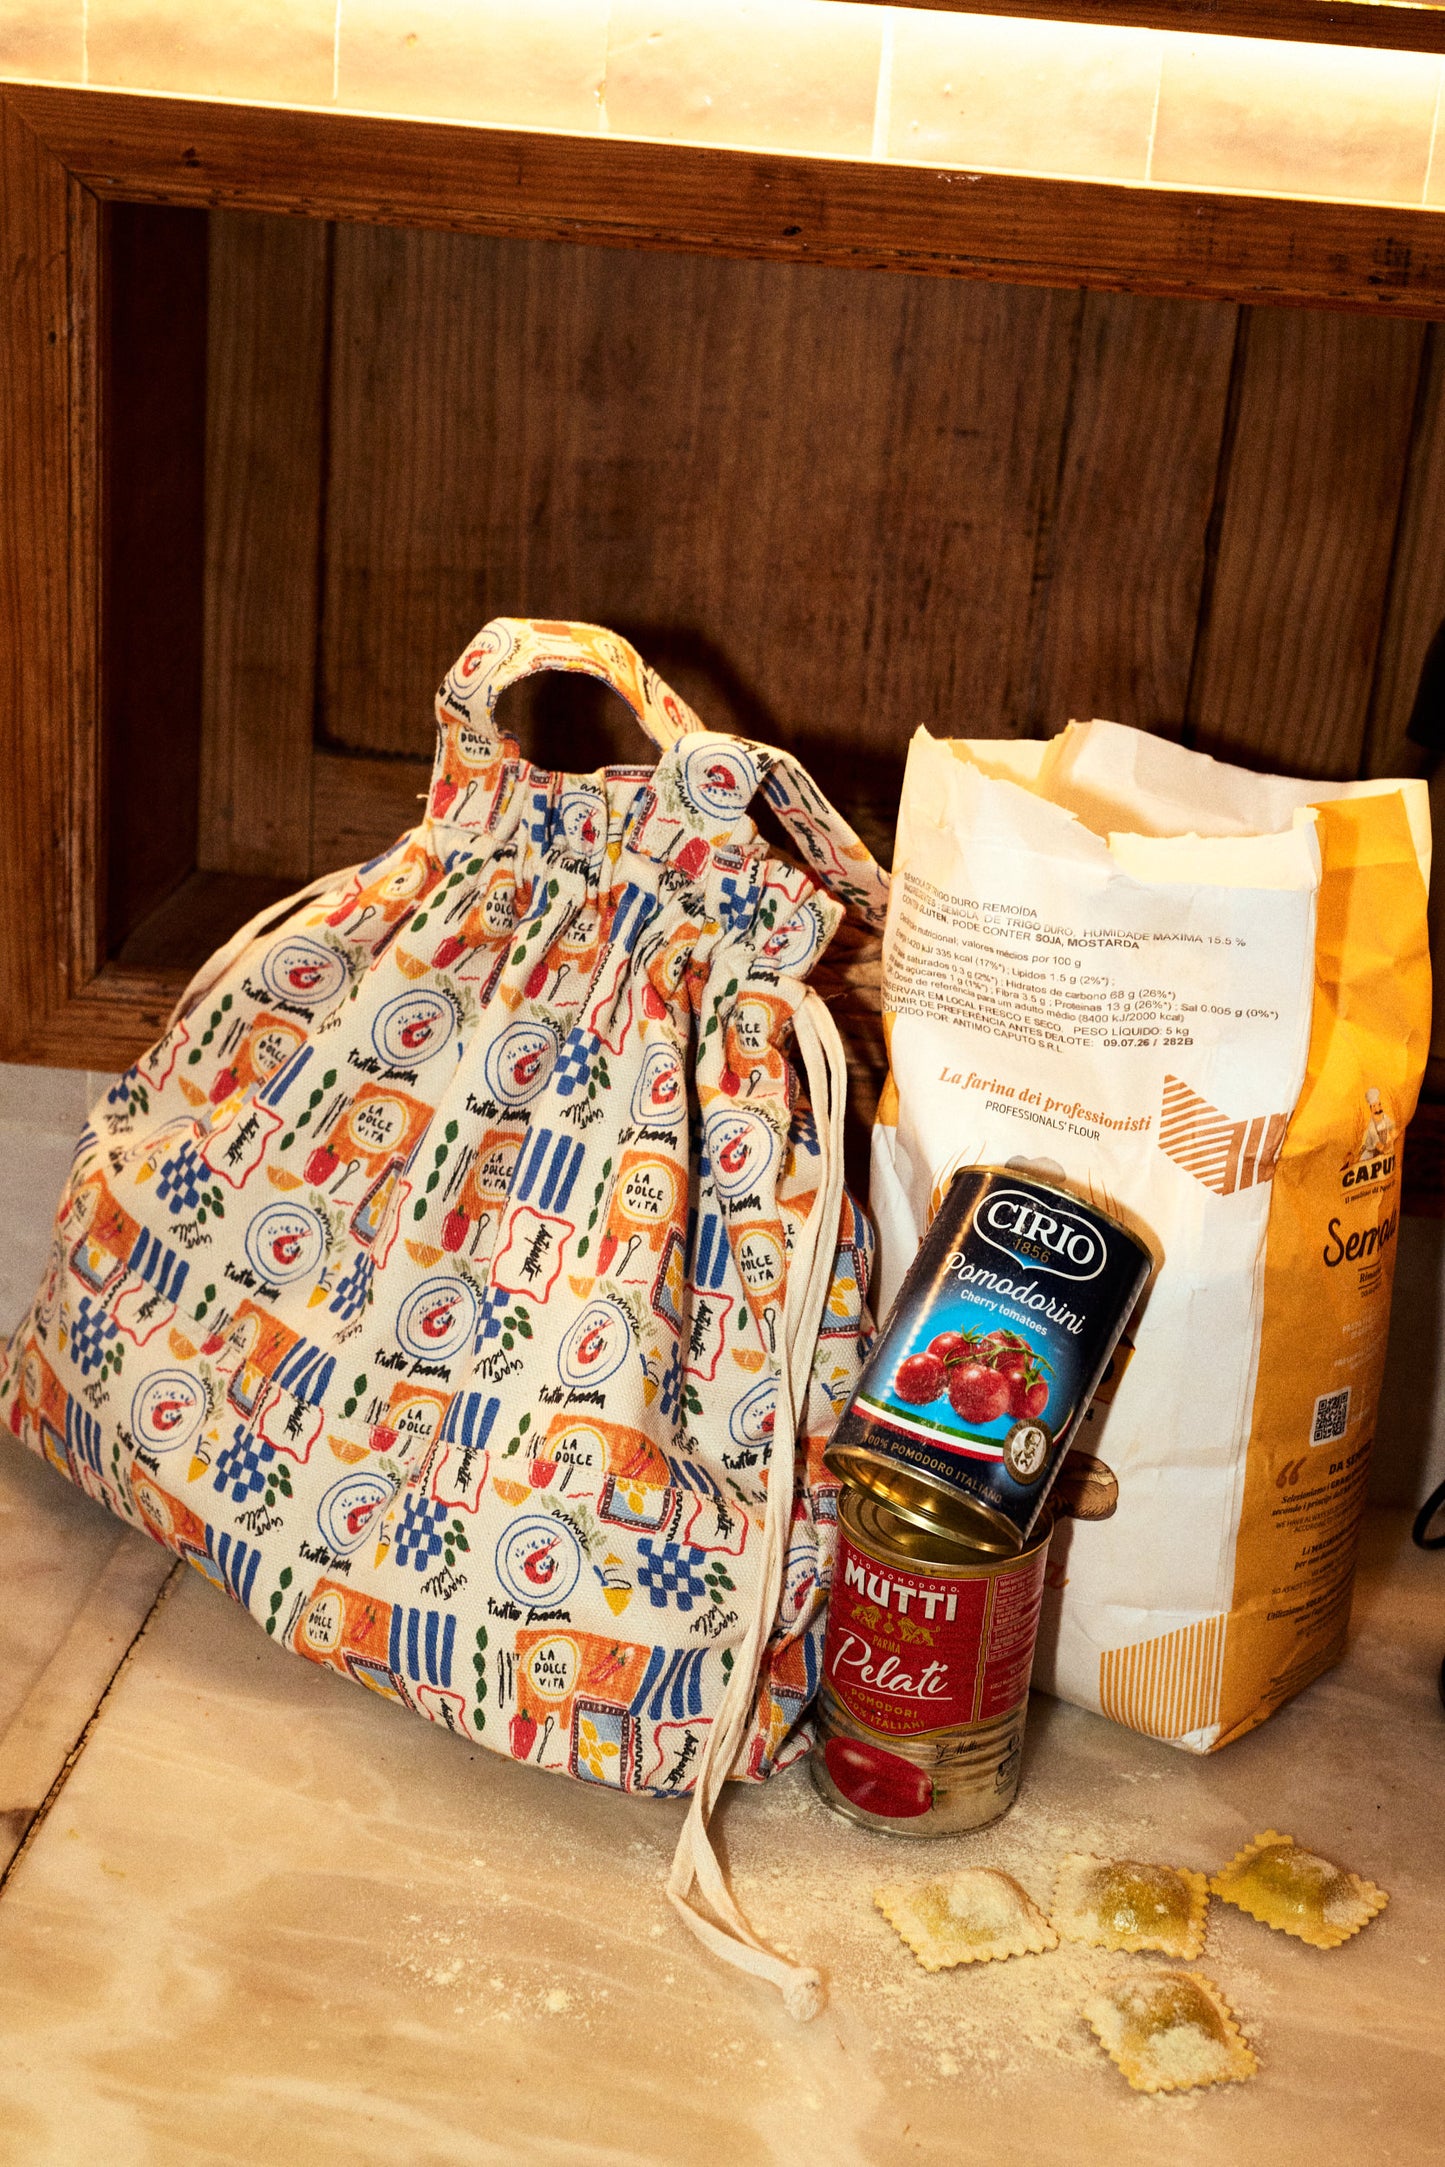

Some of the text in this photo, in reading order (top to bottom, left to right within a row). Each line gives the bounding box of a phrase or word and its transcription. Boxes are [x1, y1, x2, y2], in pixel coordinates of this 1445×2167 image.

[951, 896, 979, 910] DURO
[982, 902, 1037, 918] REMOÍDA
[952, 918, 980, 933] PODE
[982, 925, 1031, 941] CONTER
[1035, 933, 1064, 947] SOJA,
[1067, 938, 1140, 949] MOSTARDA
[1006, 917, 1041, 931] TRIGO
[1084, 929, 1150, 941] HUMIDADE
[1209, 936, 1232, 946] 15.5
[961, 940, 995, 954] valores
[1032, 954, 1050, 965] por
[1053, 955, 1072, 966] 100
[935, 946, 952, 959] 335
[954, 951, 974, 964] kcal
[1050, 973, 1067, 983] 1.5
[907, 954, 950, 971] saturados
[1006, 979, 1047, 995] Hidratos
[1050, 988, 1063, 997] de
[1065, 991, 1108, 1001] carbono
[1109, 990, 1125, 1000] 68
[894, 970, 914, 985] Dose
[916, 978, 929, 987] de
[931, 980, 976, 998] referência
[976, 993, 997, 1005] para
[1014, 1003, 1045, 1015] adulto
[1046, 1007, 1077, 1021] médio
[1078, 1013, 1109, 1024] (8400
[995, 986, 1020, 1000] Fibra
[1022, 992, 1037, 1004] 3.5
[1107, 1001, 1121, 1011] 13
[1180, 1003, 1199, 1013] Sal
[1200, 1004, 1232, 1016] 0.005
[920, 998, 935, 1010] DE
[936, 1003, 1006, 1028] PREFERÊNCIA
[1008, 1023, 1043, 1038] ANTES
[1103, 1038, 1150, 1048] 09.07.26
[1162, 1037, 1194, 1047] 282B
[927, 991, 944, 1002] EM
[945, 996, 976, 1011] LOCAL
[978, 1003, 1022, 1022] FRESCO
[1024, 1015, 1031, 1025] E
[1073, 1026, 1109, 1037] PESO
[1111, 1026, 1163, 1037] LÍQUIDO:
[1165, 1027, 1173, 1036] 5
[1175, 1027, 1190, 1038] kg
[952, 1017, 991, 1035] ANTIMO
[993, 1027, 1037, 1046] CAPUTO
[368, 1104, 384, 1117] LA
[939, 1067, 1152, 1132] La farina dei professionisti
[357, 1112, 394, 1133] DOLCE
[1068, 1123, 1100, 1141] FLOUR
[489, 1152, 502, 1163] LA
[482, 1164, 513, 1177] DOLCE
[634, 1173, 650, 1184] LA
[625, 1184, 664, 1200] DOLCE
[987, 1200, 1095, 1265] CIRIO
[741, 1245, 754, 1259] LA
[1014, 1238, 1051, 1263] 1856
[740, 1253, 774, 1273] DOLCE
[942, 1251, 1087, 1335] Pomodorini
[960, 1289, 1049, 1336] Cherry tomatoes
[406, 1408, 423, 1421] LA
[397, 1420, 433, 1436] DOLCE
[562, 1438, 578, 1450] LA
[554, 1450, 593, 1467] DOLCE
[863, 1434, 1003, 1504] 100% POMODORO ITALIANO
[844, 1556, 958, 1622] MUTTI
[316, 1602, 328, 1614] LA
[308, 1614, 333, 1630] DOLCE
[539, 1650, 555, 1661] LA
[872, 1635, 901, 1655] PARMA
[534, 1662, 568, 1675] DOLCE
[832, 1627, 949, 1699] Pelati
[851, 1688, 918, 1719] POMODORI
[870, 1714, 925, 1731] ITALIANI
